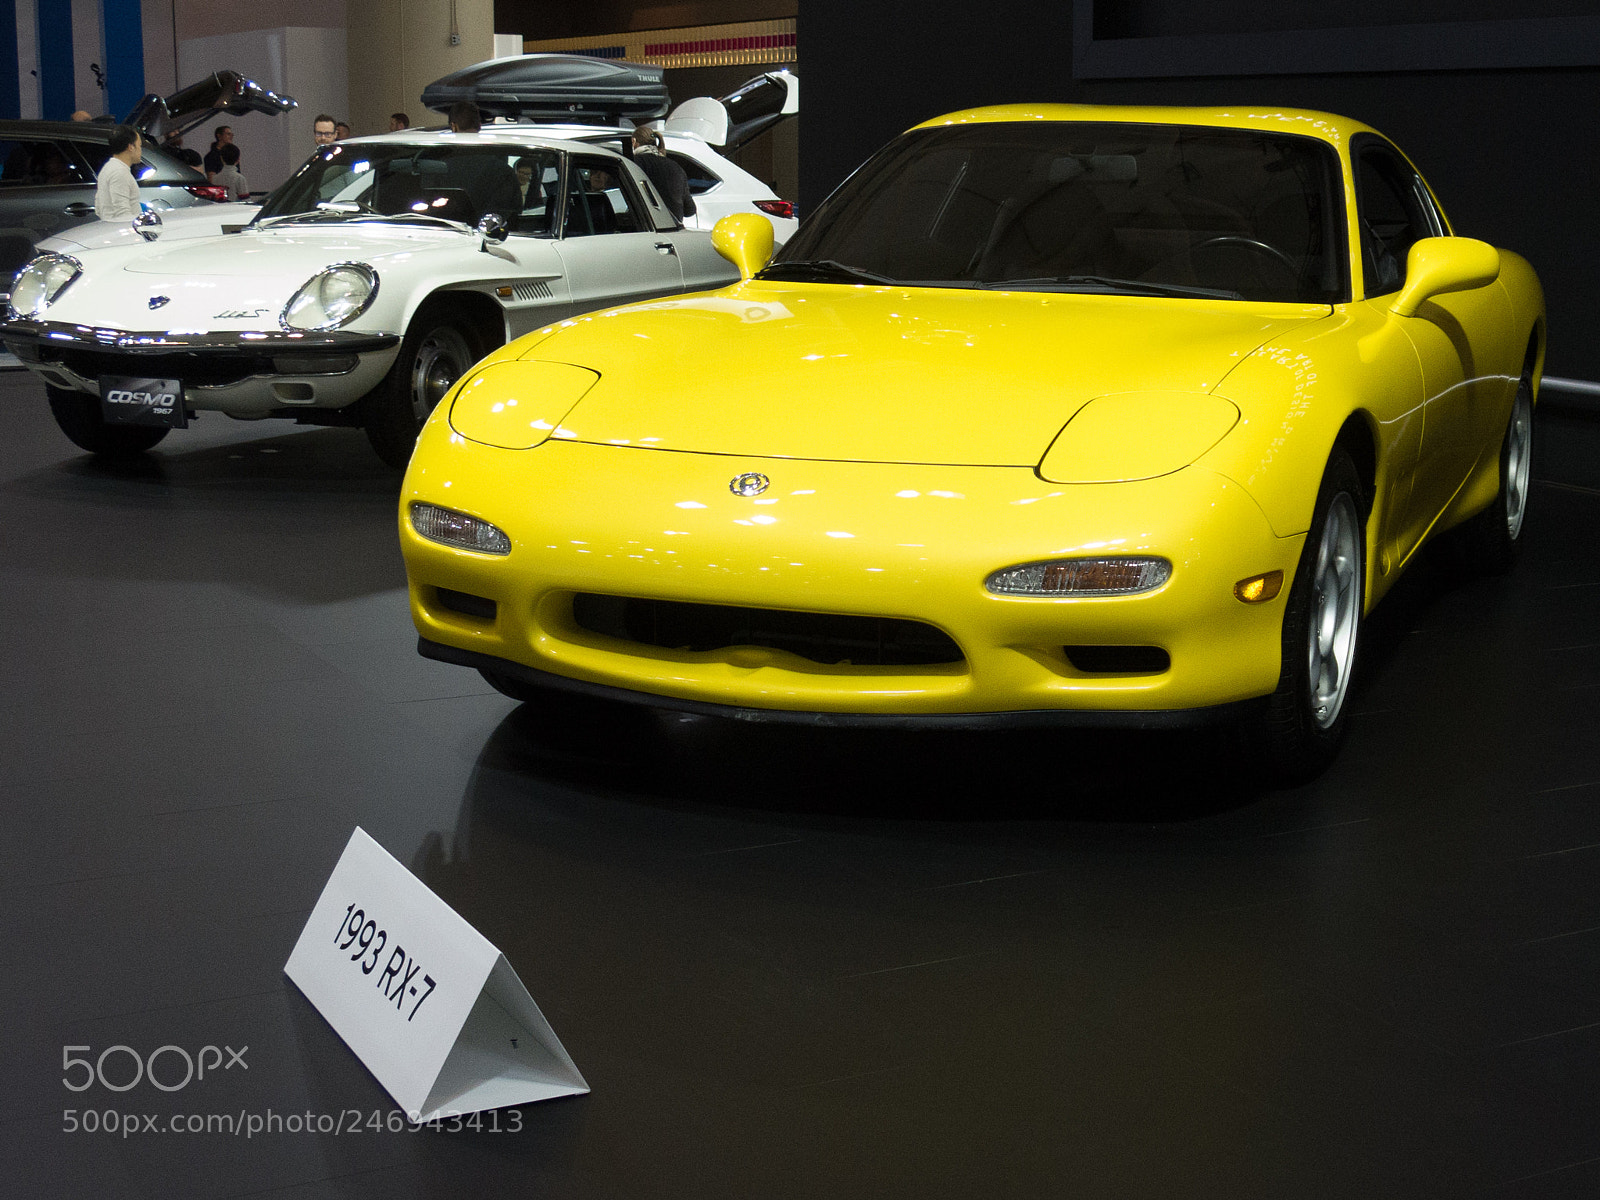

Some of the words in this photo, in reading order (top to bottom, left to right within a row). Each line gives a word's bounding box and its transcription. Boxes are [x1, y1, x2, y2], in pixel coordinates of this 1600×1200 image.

[638, 74, 660, 82] THULE
[107, 389, 176, 407] COSMO
[153, 407, 173, 415] 1967
[334, 903, 387, 975] 1993
[377, 945, 437, 1022] RX-7
